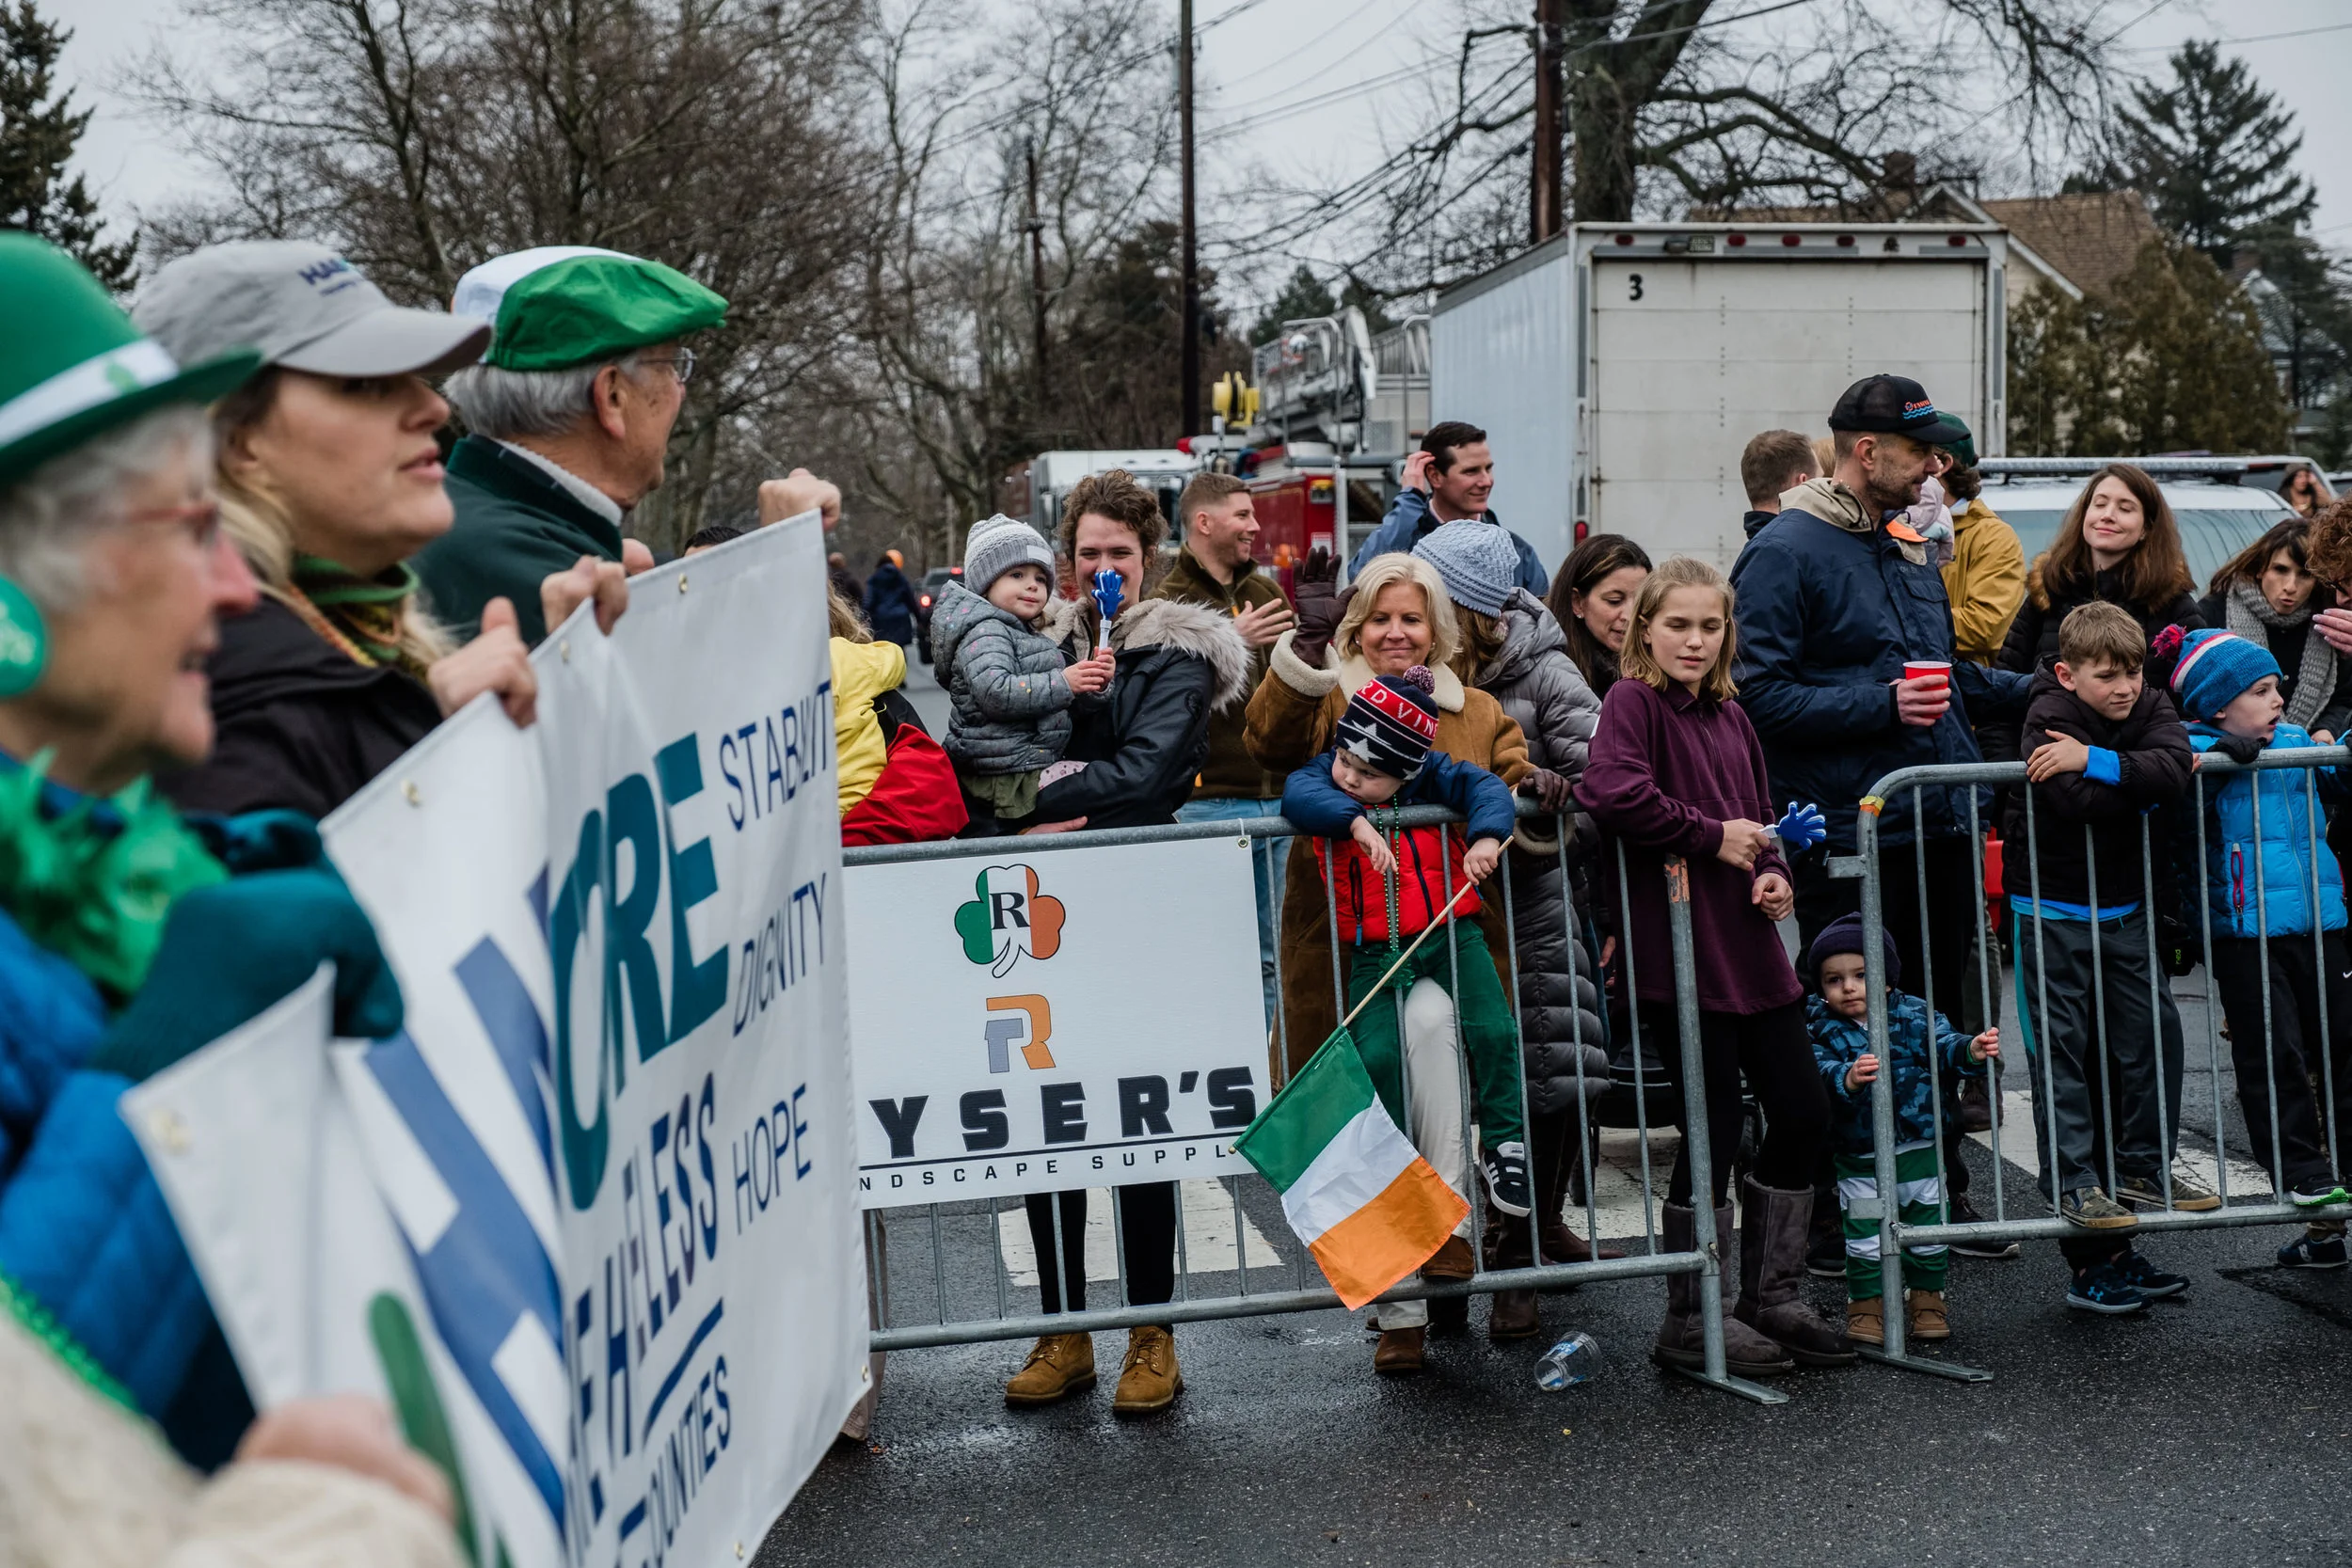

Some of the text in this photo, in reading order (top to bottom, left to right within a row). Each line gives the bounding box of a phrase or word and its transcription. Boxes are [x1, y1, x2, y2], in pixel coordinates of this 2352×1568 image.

[1629, 274, 1644, 301] 3
[720, 678, 832, 832] STABILIT
[733, 871, 826, 1037] DIGNITY
[988, 892, 1031, 930] R
[733, 1083, 811, 1235] HOPE
[867, 1066, 1258, 1159] YSER'S
[859, 1144, 1227, 1192] NDSCAPE SUPPL
